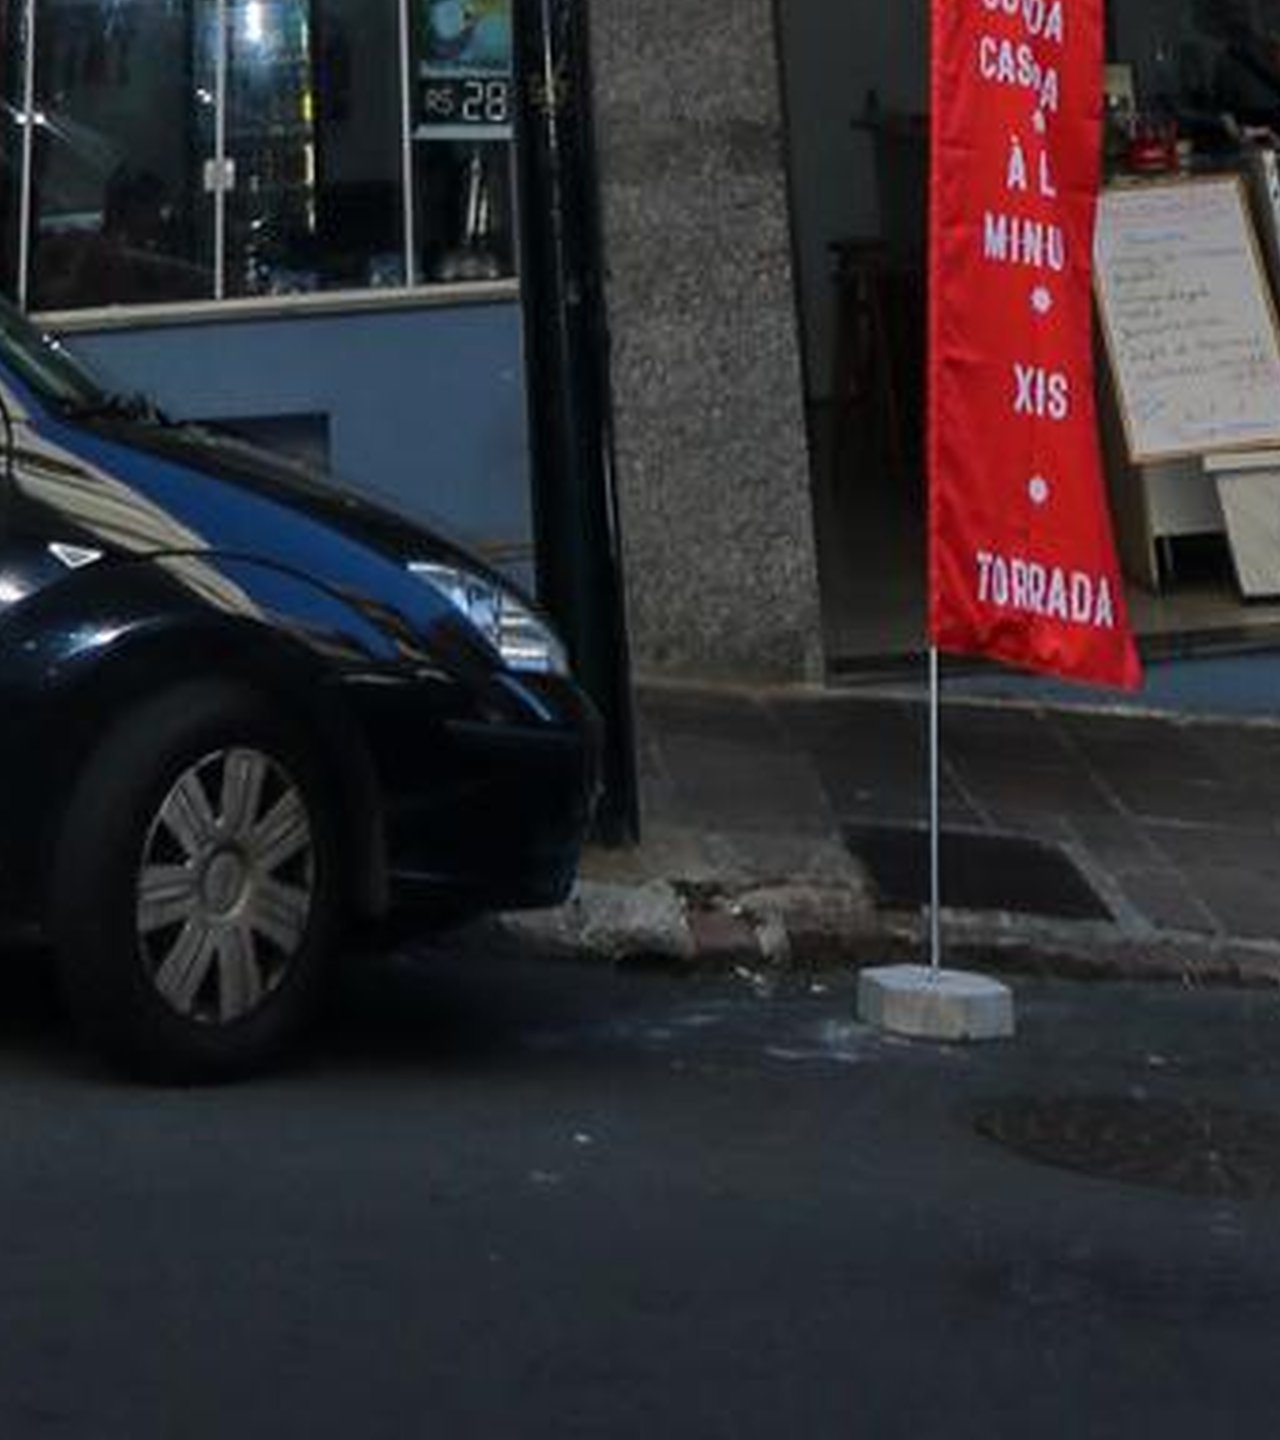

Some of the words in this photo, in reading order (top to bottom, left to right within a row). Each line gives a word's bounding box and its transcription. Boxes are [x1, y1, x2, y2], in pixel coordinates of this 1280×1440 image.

[461, 80, 508, 122] 28
[1006, 133, 1027, 192] À
[983, 209, 1065, 272] MINU
[1013, 363, 1068, 420] XIS
[974, 549, 1114, 629] TORRADA
